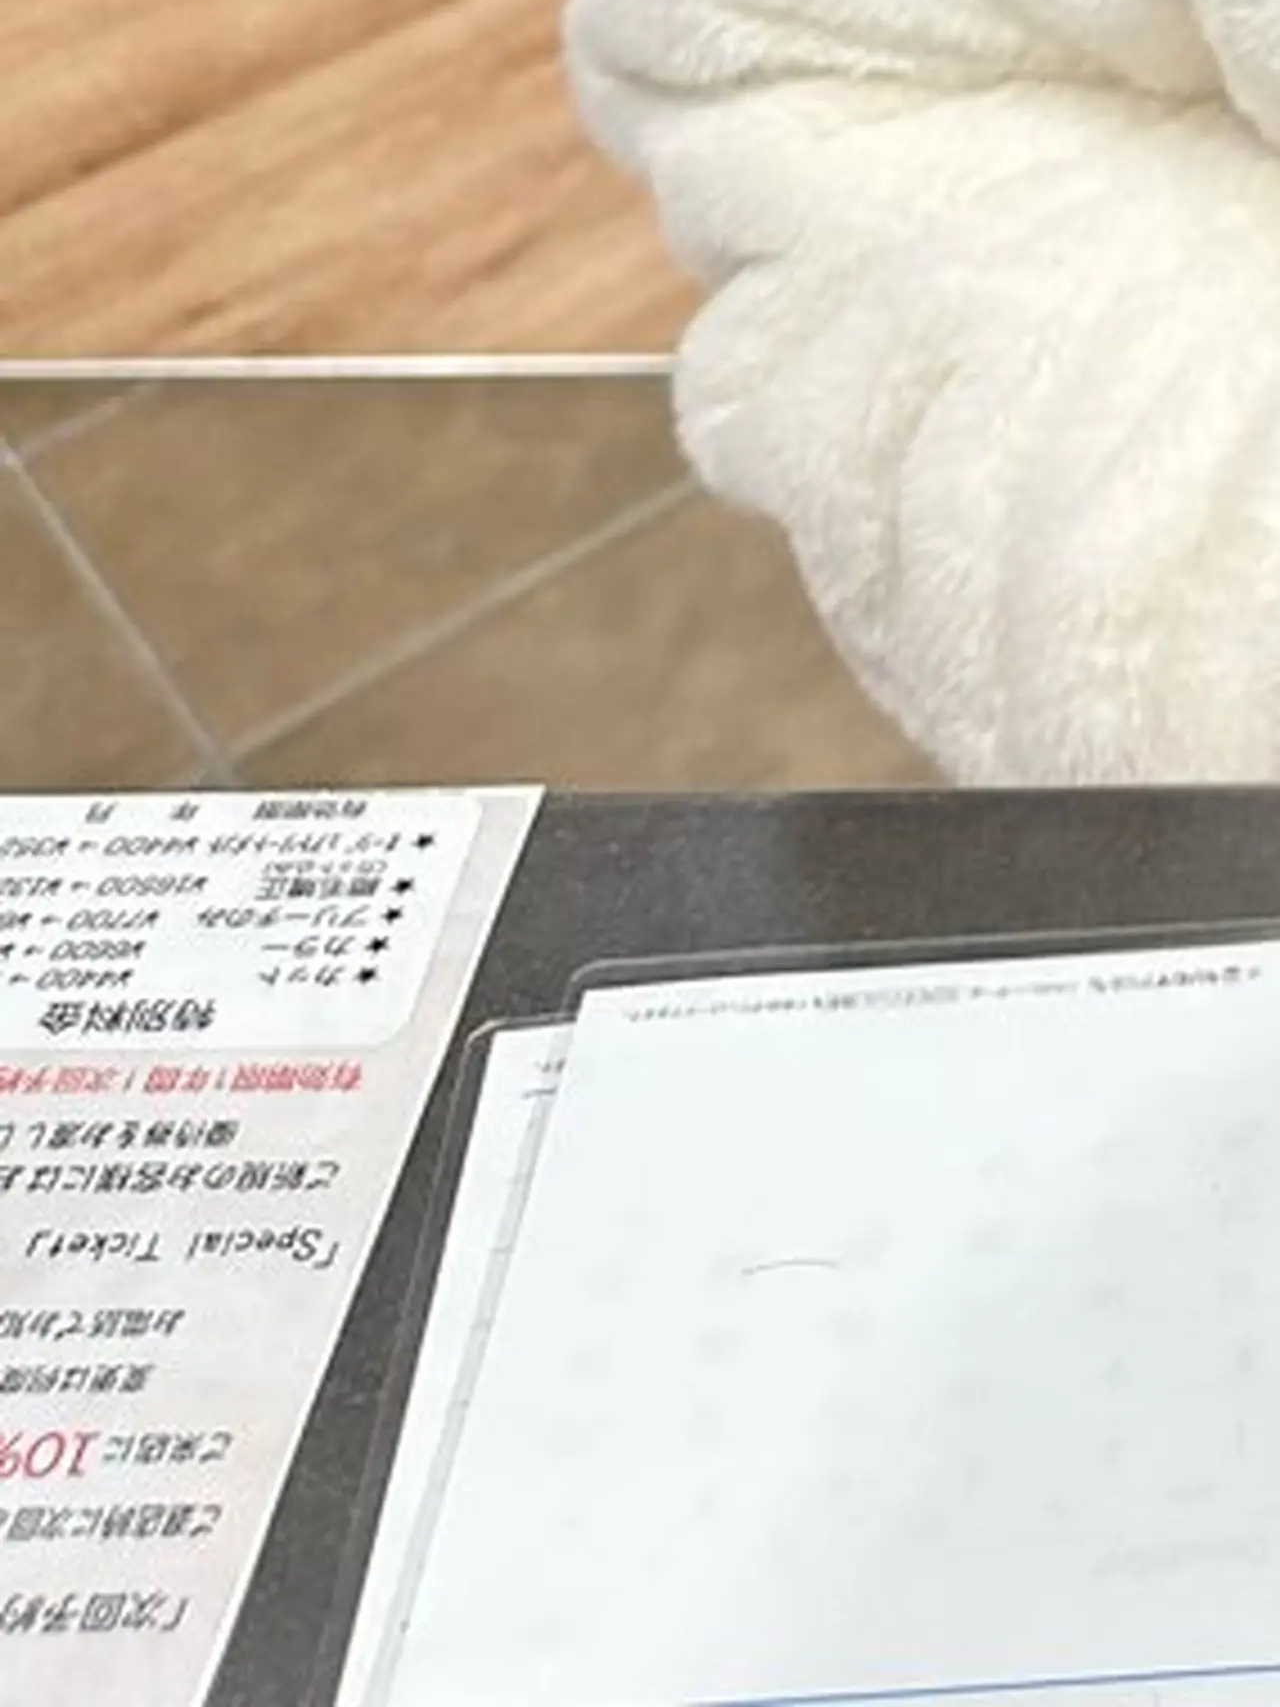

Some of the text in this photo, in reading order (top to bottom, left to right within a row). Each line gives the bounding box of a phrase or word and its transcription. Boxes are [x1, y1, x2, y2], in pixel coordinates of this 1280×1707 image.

[261, 936, 355, 958] カラー
[258, 966, 344, 986] カット
[39, 999, 217, 1037] 特別料金
